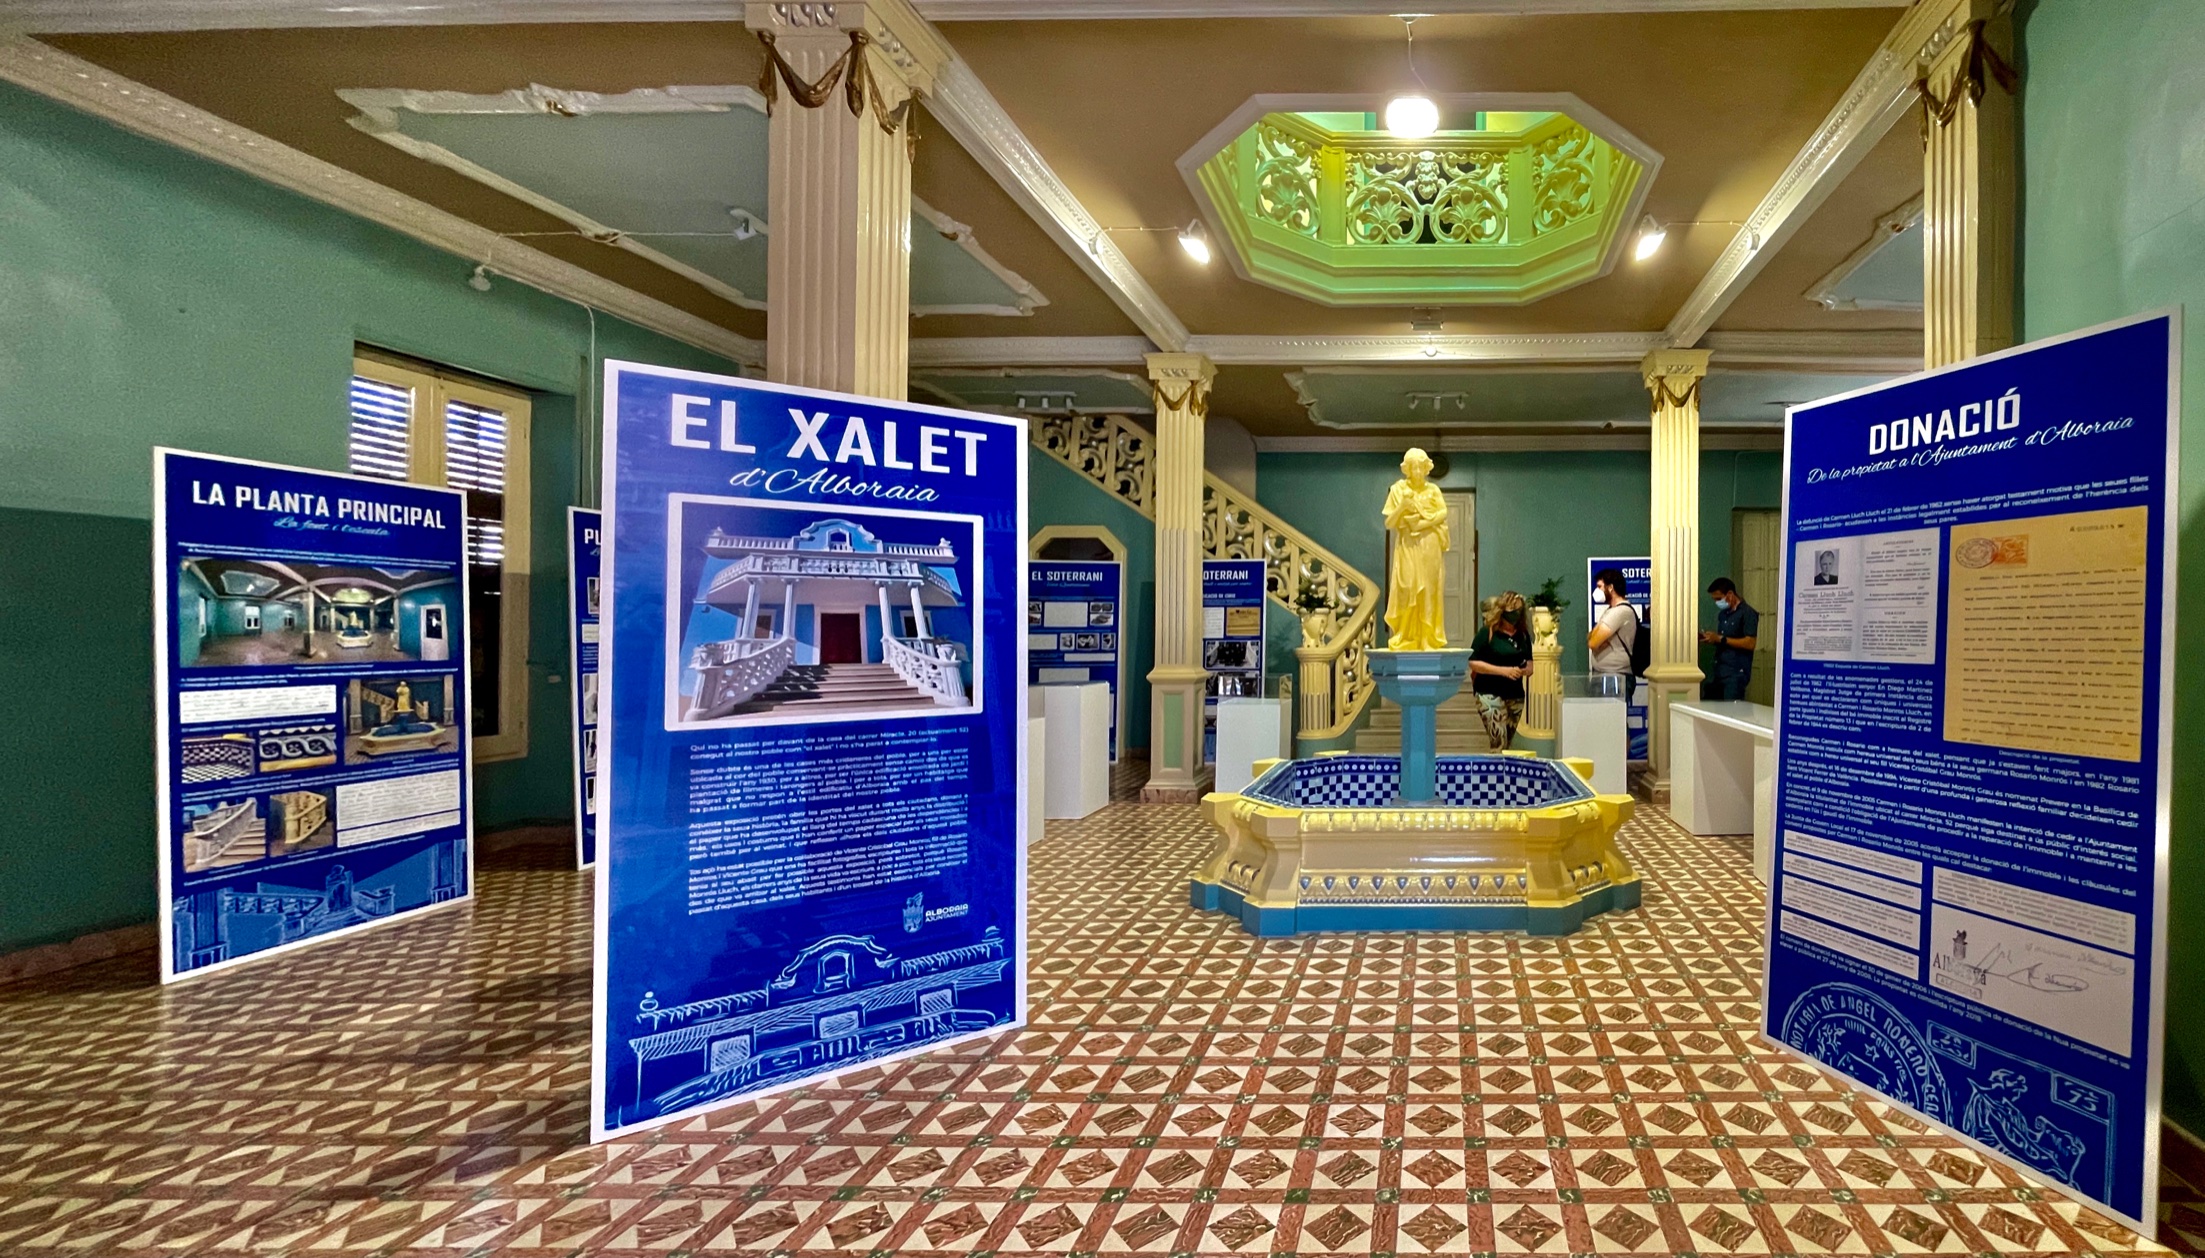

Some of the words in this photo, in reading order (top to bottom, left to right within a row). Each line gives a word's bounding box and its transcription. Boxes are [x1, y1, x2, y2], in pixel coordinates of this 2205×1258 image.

[671, 394, 756, 454] EL
[786, 408, 988, 477] XALET
[1869, 387, 2020, 455] DONACIÓ
[1807, 468, 1826, 485] De
[1827, 465, 1840, 481] la
[1841, 456, 1896, 481] propietat
[1899, 457, 1909, 467] a
[1910, 436, 2018, 467] l'Ajuntament
[2025, 414, 2135, 446] d'Alboraia
[730, 466, 940, 502] d'Alboraia
[193, 480, 226, 506] LA
[236, 486, 330, 518] PLANTA
[338, 498, 446, 530] PRINCIPAL
[1031, 570, 1043, 581] EL
[1046, 571, 1103, 582] SOTERRANI
[1203, 570, 1248, 580] OTERRANI
[1622, 568, 1651, 578] SOTER
[1929, 758, 1945, 767] béns
[1959, 764, 1975, 772] seua
[1976, 766, 2008, 778] germana
[2009, 769, 2038, 780] Rosario
[2038, 773, 2068, 784] Monrós
[2086, 779, 2105, 790] 1982
[2107, 782, 2140, 794] Rosario
[1943, 752, 1970, 764] pensant
[1972, 758, 1986, 767] que
[1998, 759, 2031, 771] s'estaven
[2033, 763, 2049, 773] fent
[2098, 772, 2118, 784] l'any
[2121, 775, 2140, 785] 1981
[1899, 774, 1921, 784] Vicente
[1921, 777, 1950, 789] Cristóbal
[1951, 782, 1976, 793] Monrós
[1976, 786, 1994, 796] Grau
[2004, 790, 2038, 803] nomenat
[2039, 795, 2070, 808] Prevere
[2092, 803, 2125, 817] Basílica
[1939, 788, 1970, 802] profunda
[1975, 796, 2007, 808] generosa
[2008, 799, 2036, 811] reflexió
[2037, 804, 2067, 817] familiar
[2068, 809, 2115, 825] decideixen
[2116, 817, 2138, 829] cedir
[925, 903, 968, 917] ALBORAIA
[1840, 995, 1876, 1022] ANGEL
